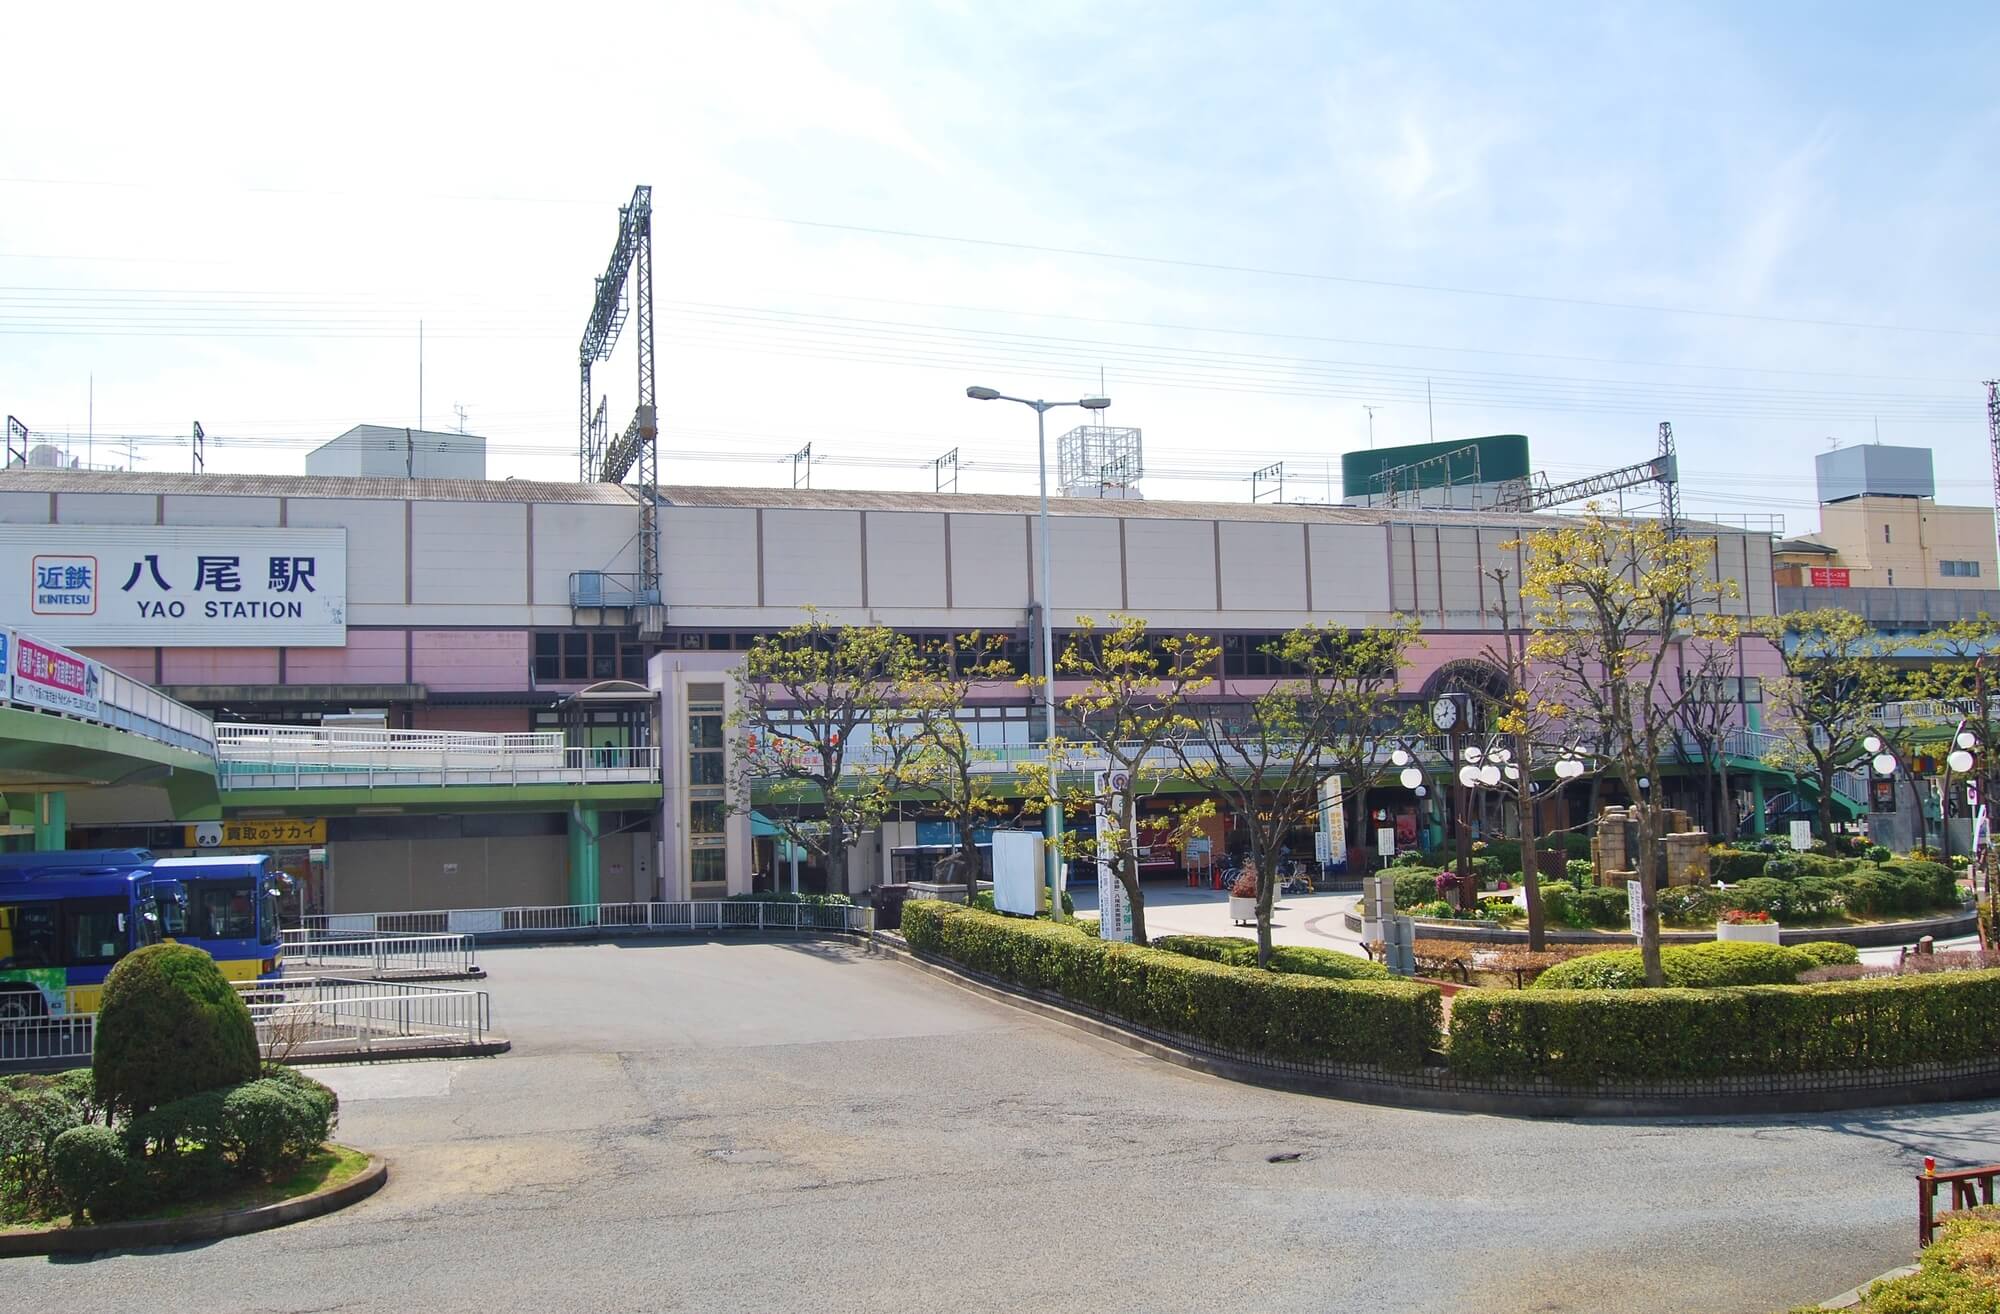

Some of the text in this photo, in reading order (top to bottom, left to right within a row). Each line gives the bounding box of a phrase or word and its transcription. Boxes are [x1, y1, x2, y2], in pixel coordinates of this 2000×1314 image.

[38, 566, 92, 590] 近鉄
[121, 555, 316, 592] 八尾駅
[39, 594, 90, 605] KINTETSU
[137, 601, 302, 618] YAO STATION
[227, 825, 316, 840] 買取のサカイ
